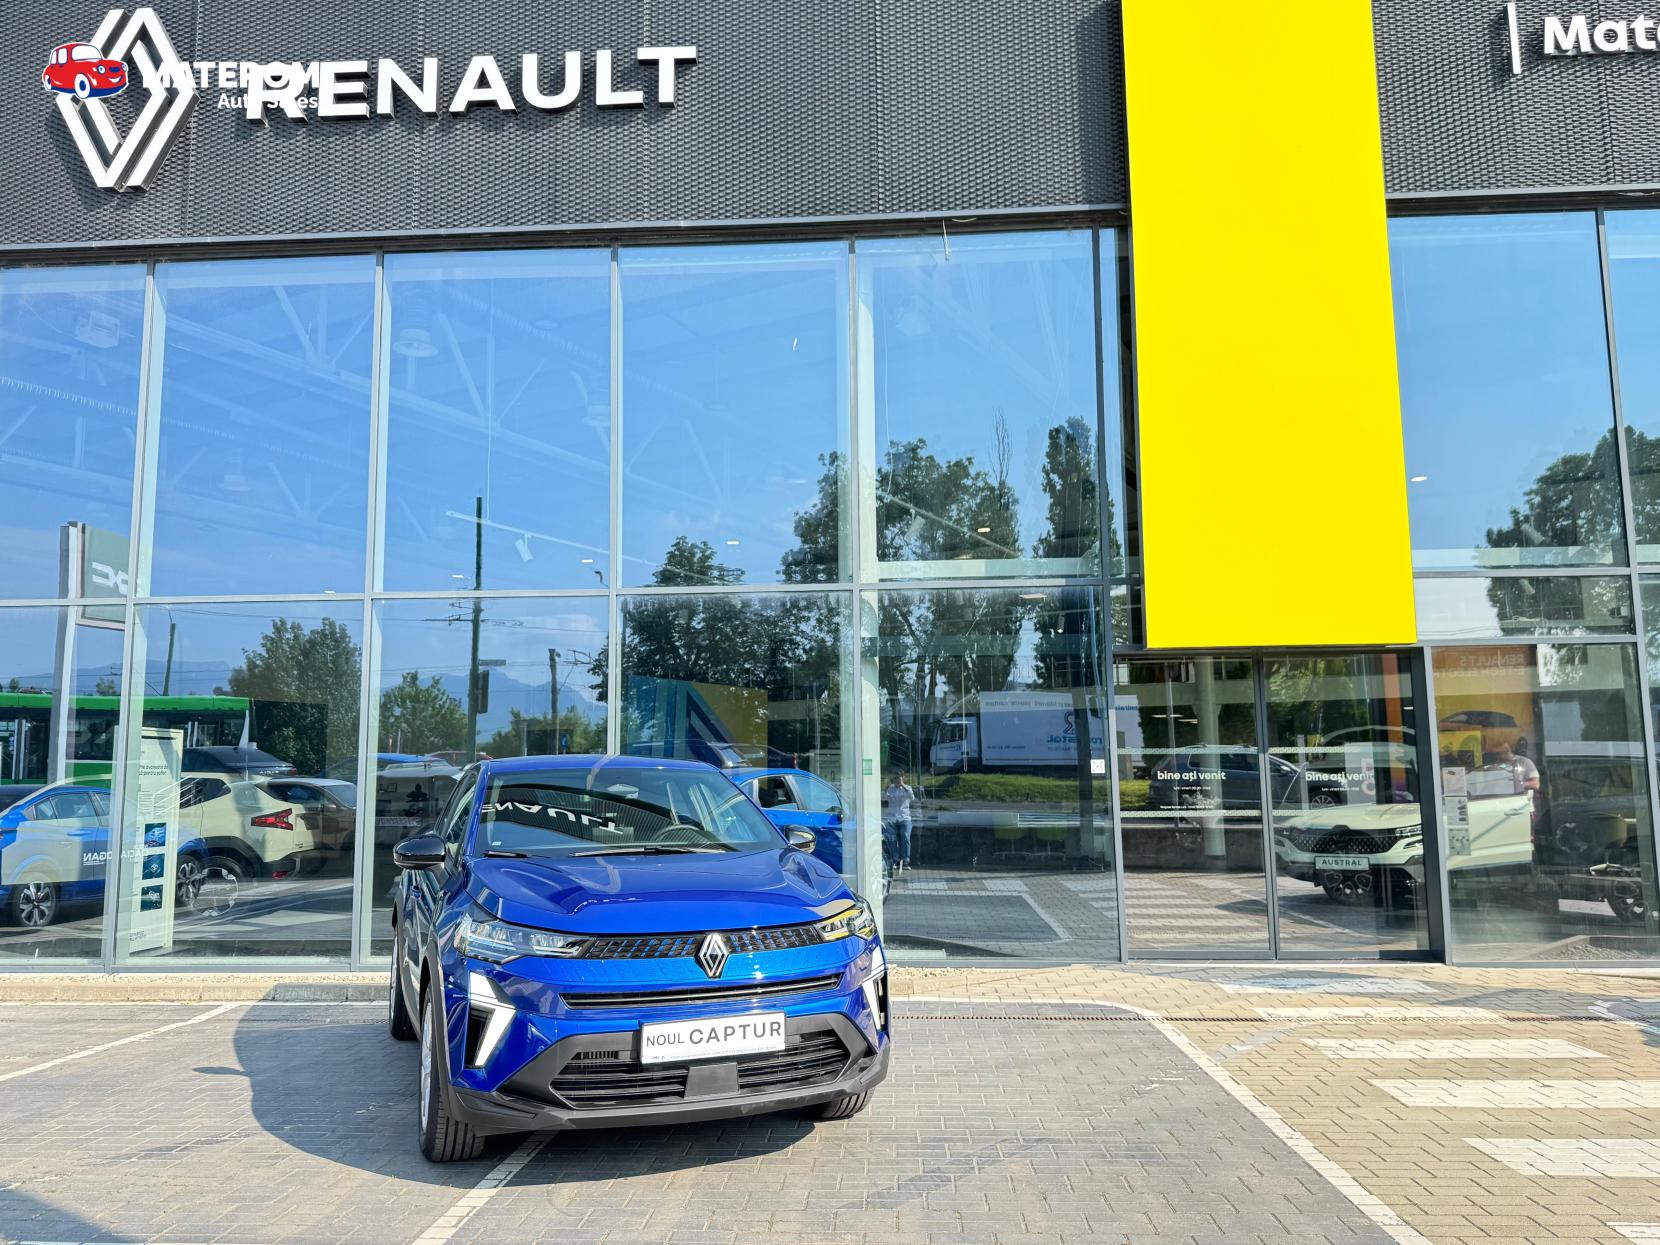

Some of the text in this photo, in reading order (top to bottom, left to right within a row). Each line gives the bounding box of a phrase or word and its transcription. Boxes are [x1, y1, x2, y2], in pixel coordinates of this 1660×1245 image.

[1544, 14, 1660, 54] Mat
[246, 46, 699, 120] RENAULT
[1157, 770, 1180, 781] bine
[1198, 769, 1227, 780] venit
[1305, 771, 1329, 781] bine
[1346, 771, 1374, 781] venit
[646, 1021, 782, 1047] NOUL CAPTUR
